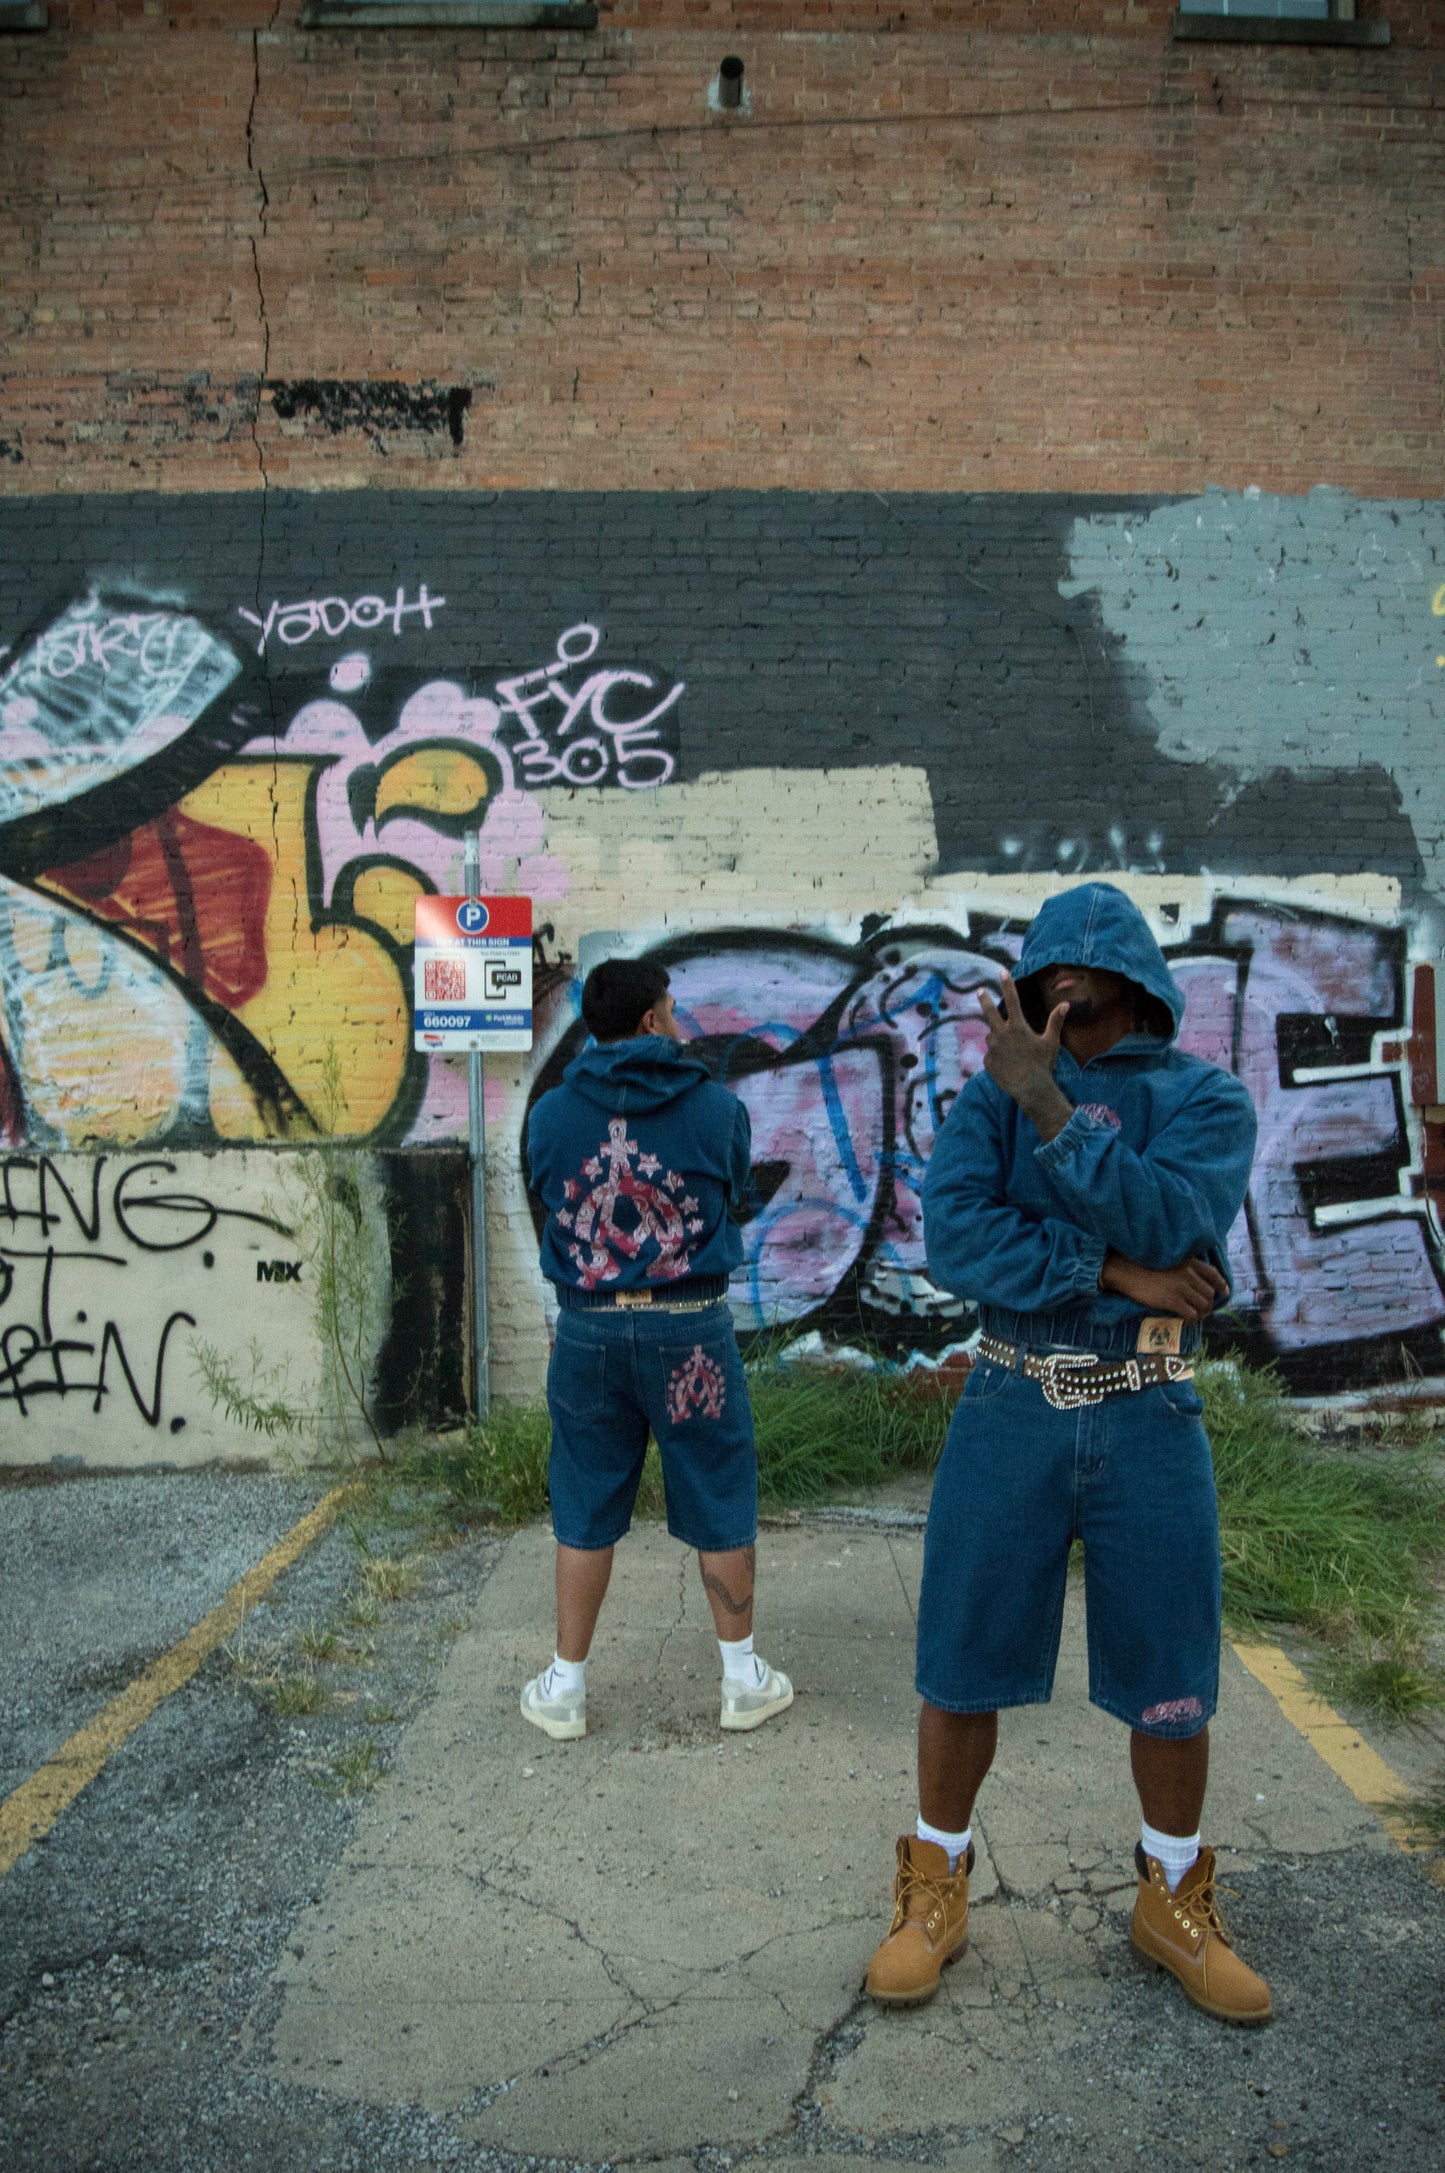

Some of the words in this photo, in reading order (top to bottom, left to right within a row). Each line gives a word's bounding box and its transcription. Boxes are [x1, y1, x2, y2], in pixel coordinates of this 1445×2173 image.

[513, 731, 675, 788] 305
[466, 906, 481, 928] P
[467, 937, 487, 947] THIS
[489, 937, 510, 947] SIGN
[423, 1015, 472, 1028] 660097
